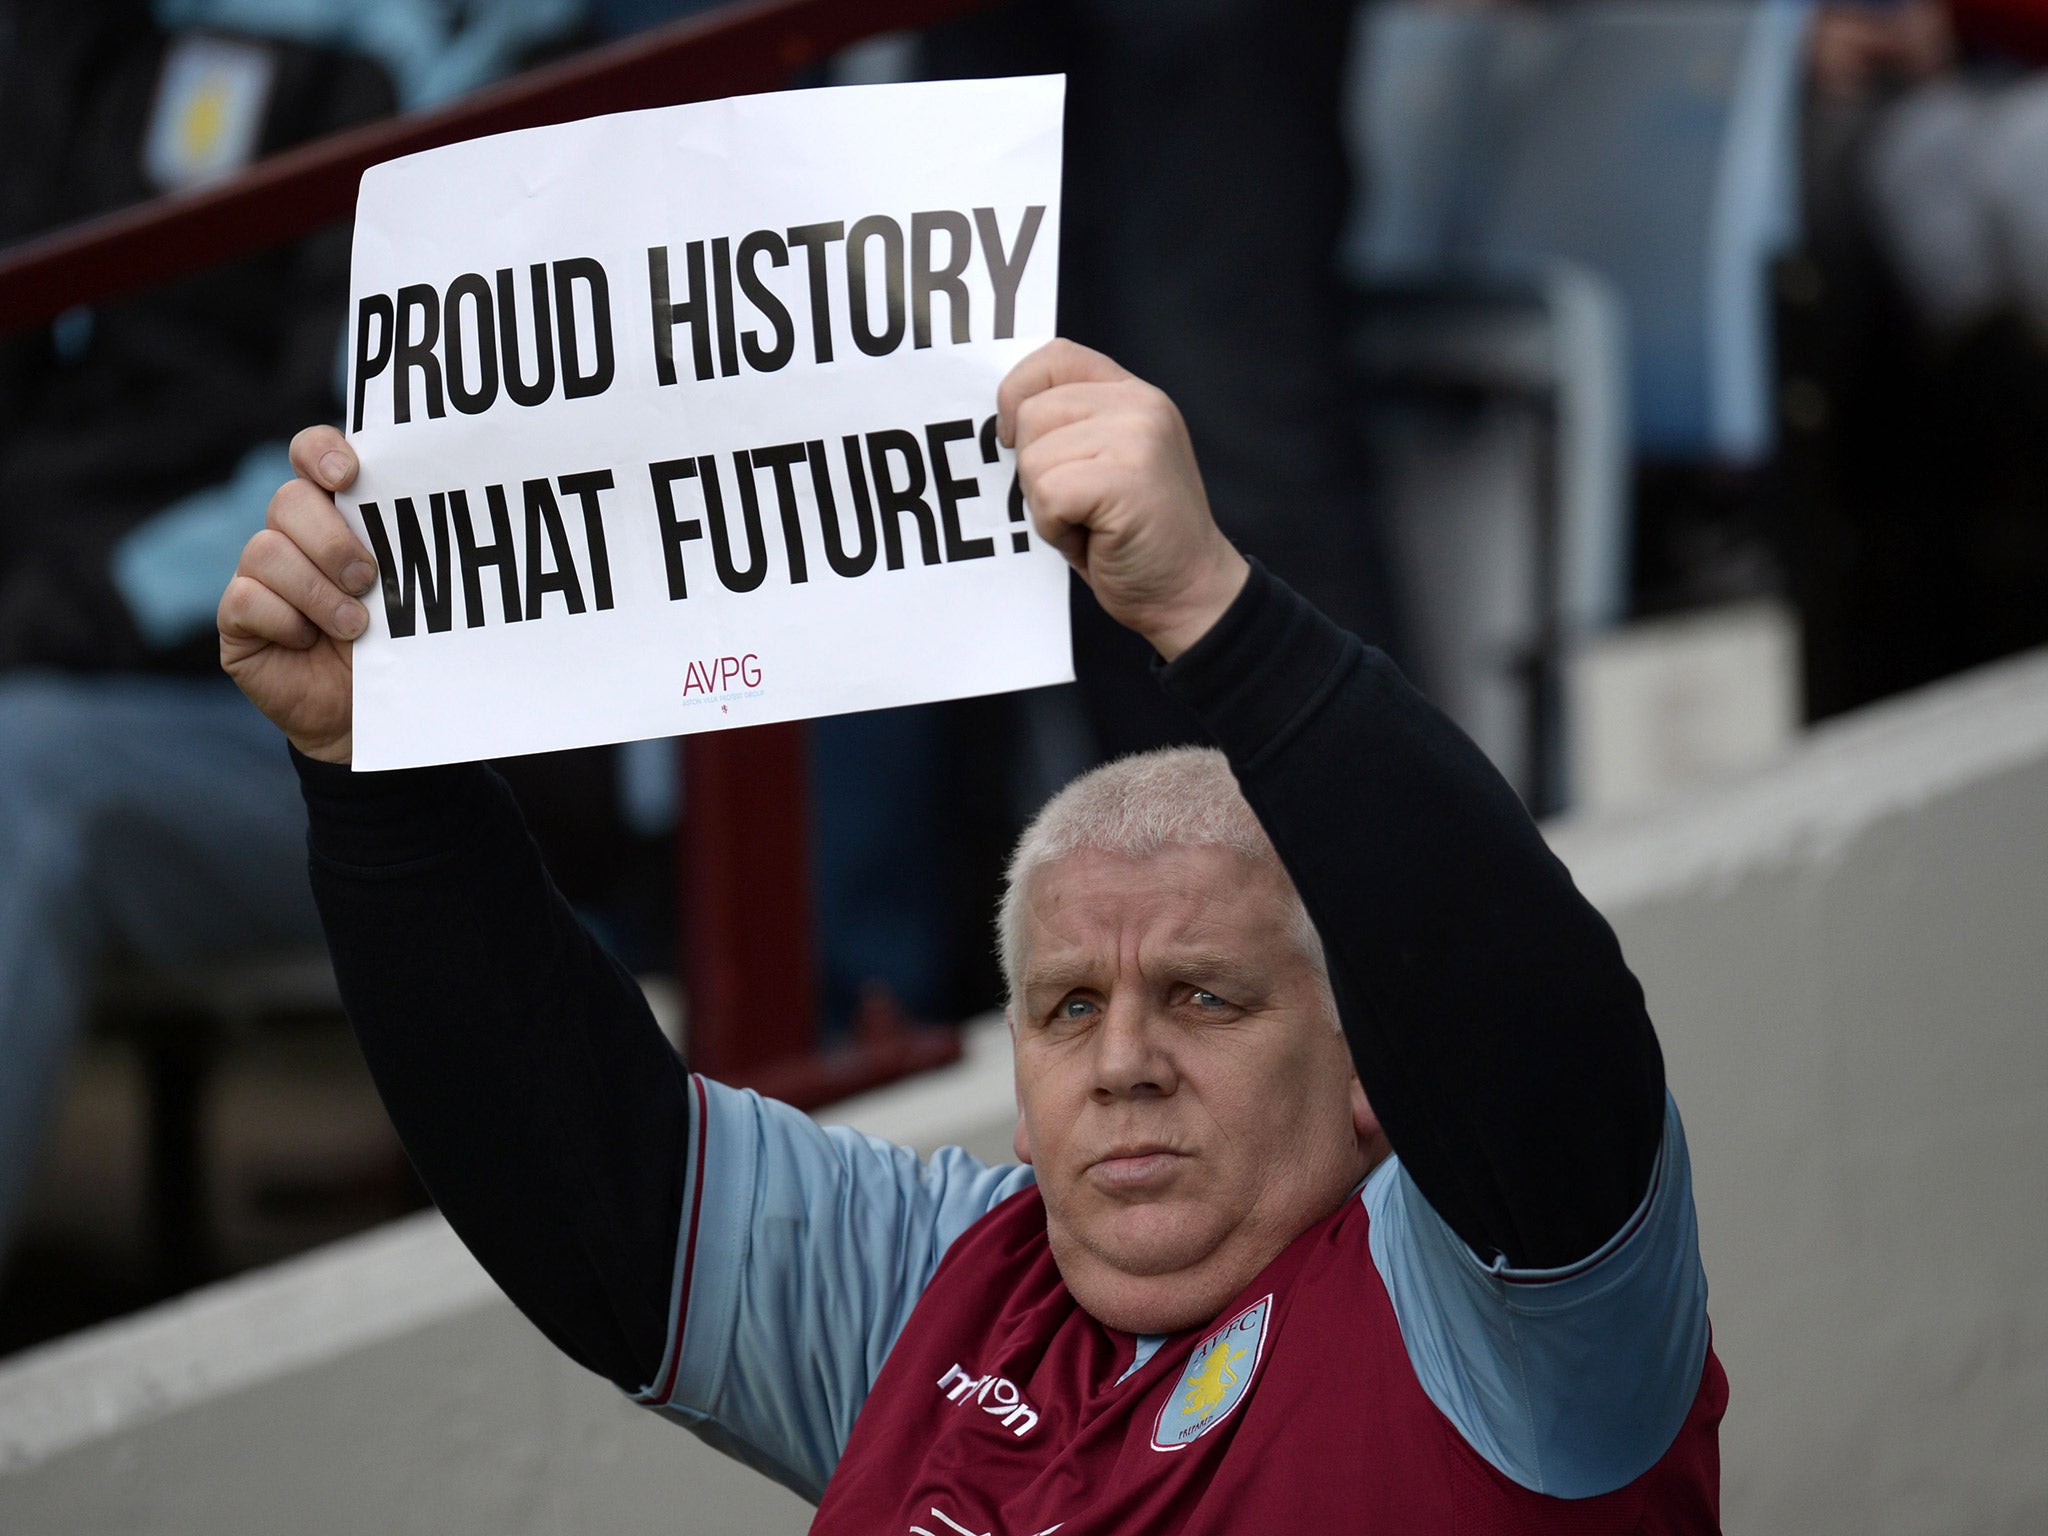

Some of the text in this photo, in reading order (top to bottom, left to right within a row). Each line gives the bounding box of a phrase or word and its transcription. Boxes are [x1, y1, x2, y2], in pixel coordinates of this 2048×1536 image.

[352, 205, 1046, 433] PROUD HISTORY
[358, 469, 614, 639] WHAT
[683, 654, 762, 697] AVPG
